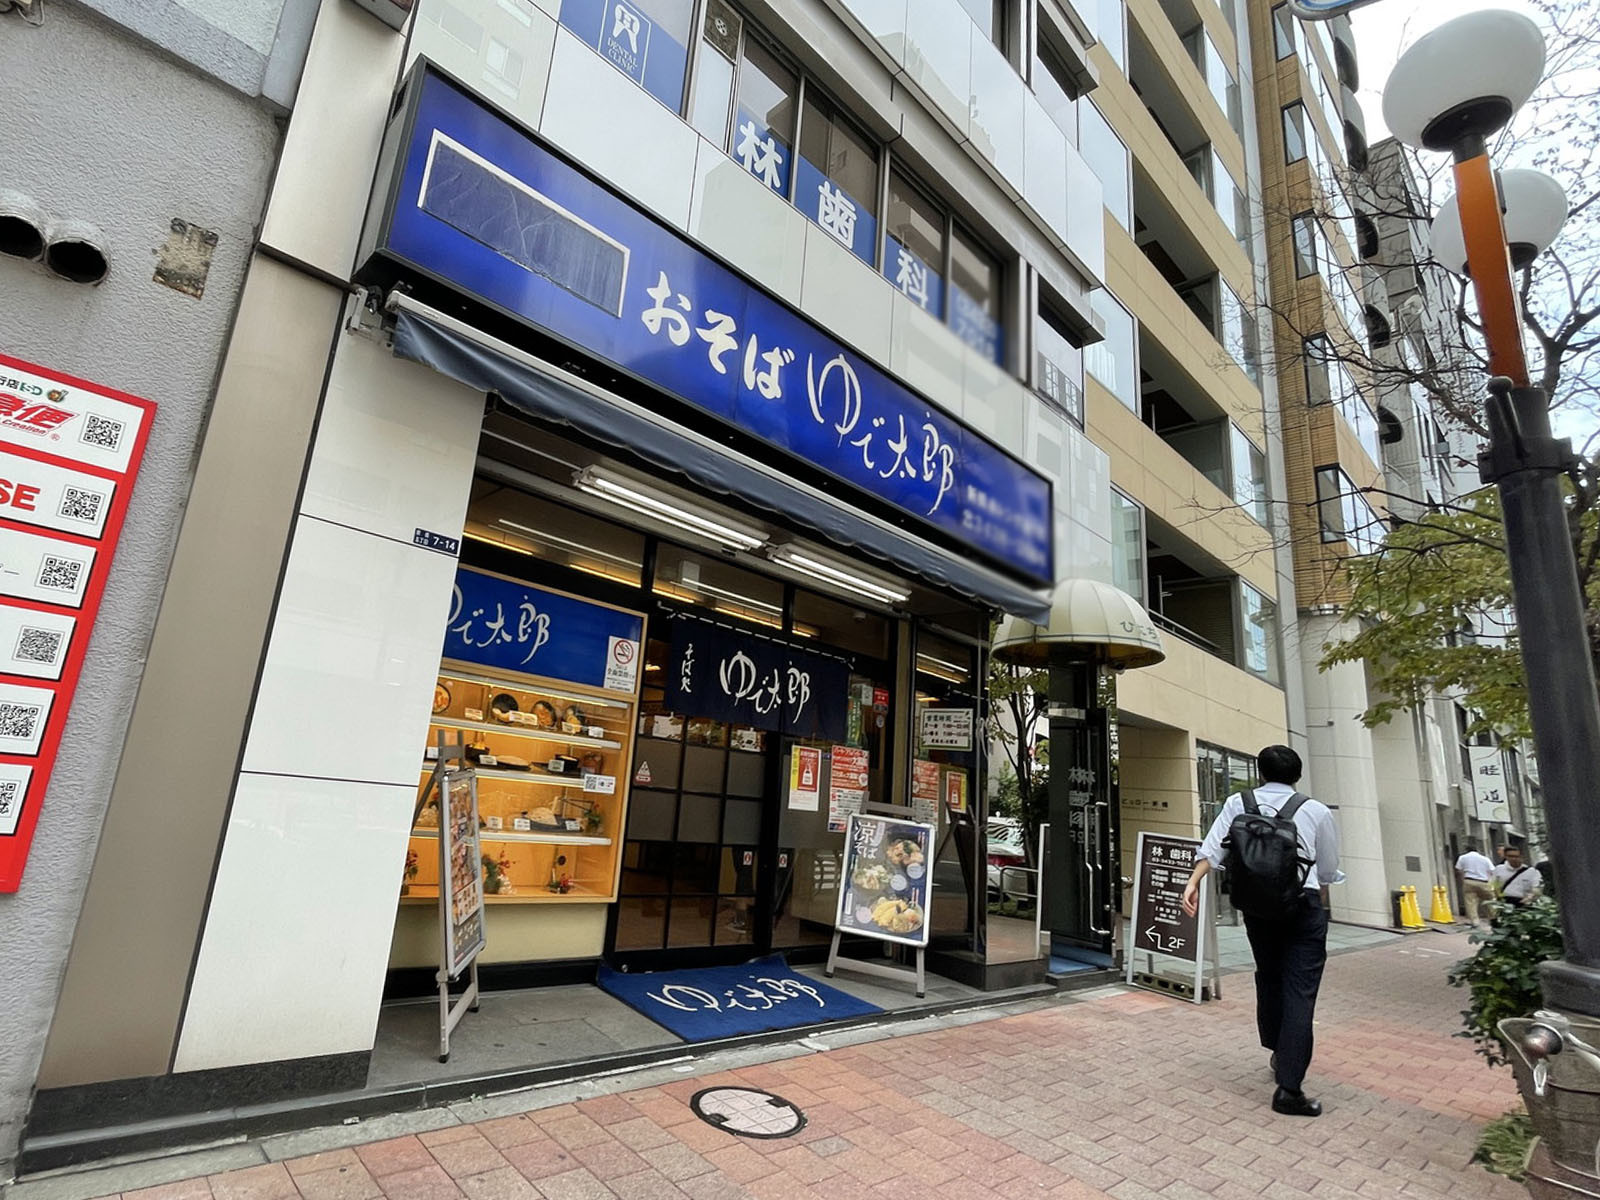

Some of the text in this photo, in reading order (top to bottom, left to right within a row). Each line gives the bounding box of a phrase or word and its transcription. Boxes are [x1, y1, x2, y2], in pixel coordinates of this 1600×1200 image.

[607, 37, 638, 68] DENTAL
[608, 48, 635, 74] CLINIC
[641, 271, 796, 400] おそば
[807, 353, 955, 517] ゆで太郎
[1, 419, 47, 435] Creation
[432, 535, 456, 551] 7-14
[719, 650, 811, 724] ゆで太郎
[1168, 936, 1186, 950] 2F
[647, 975, 825, 1013] ゆで太郎
